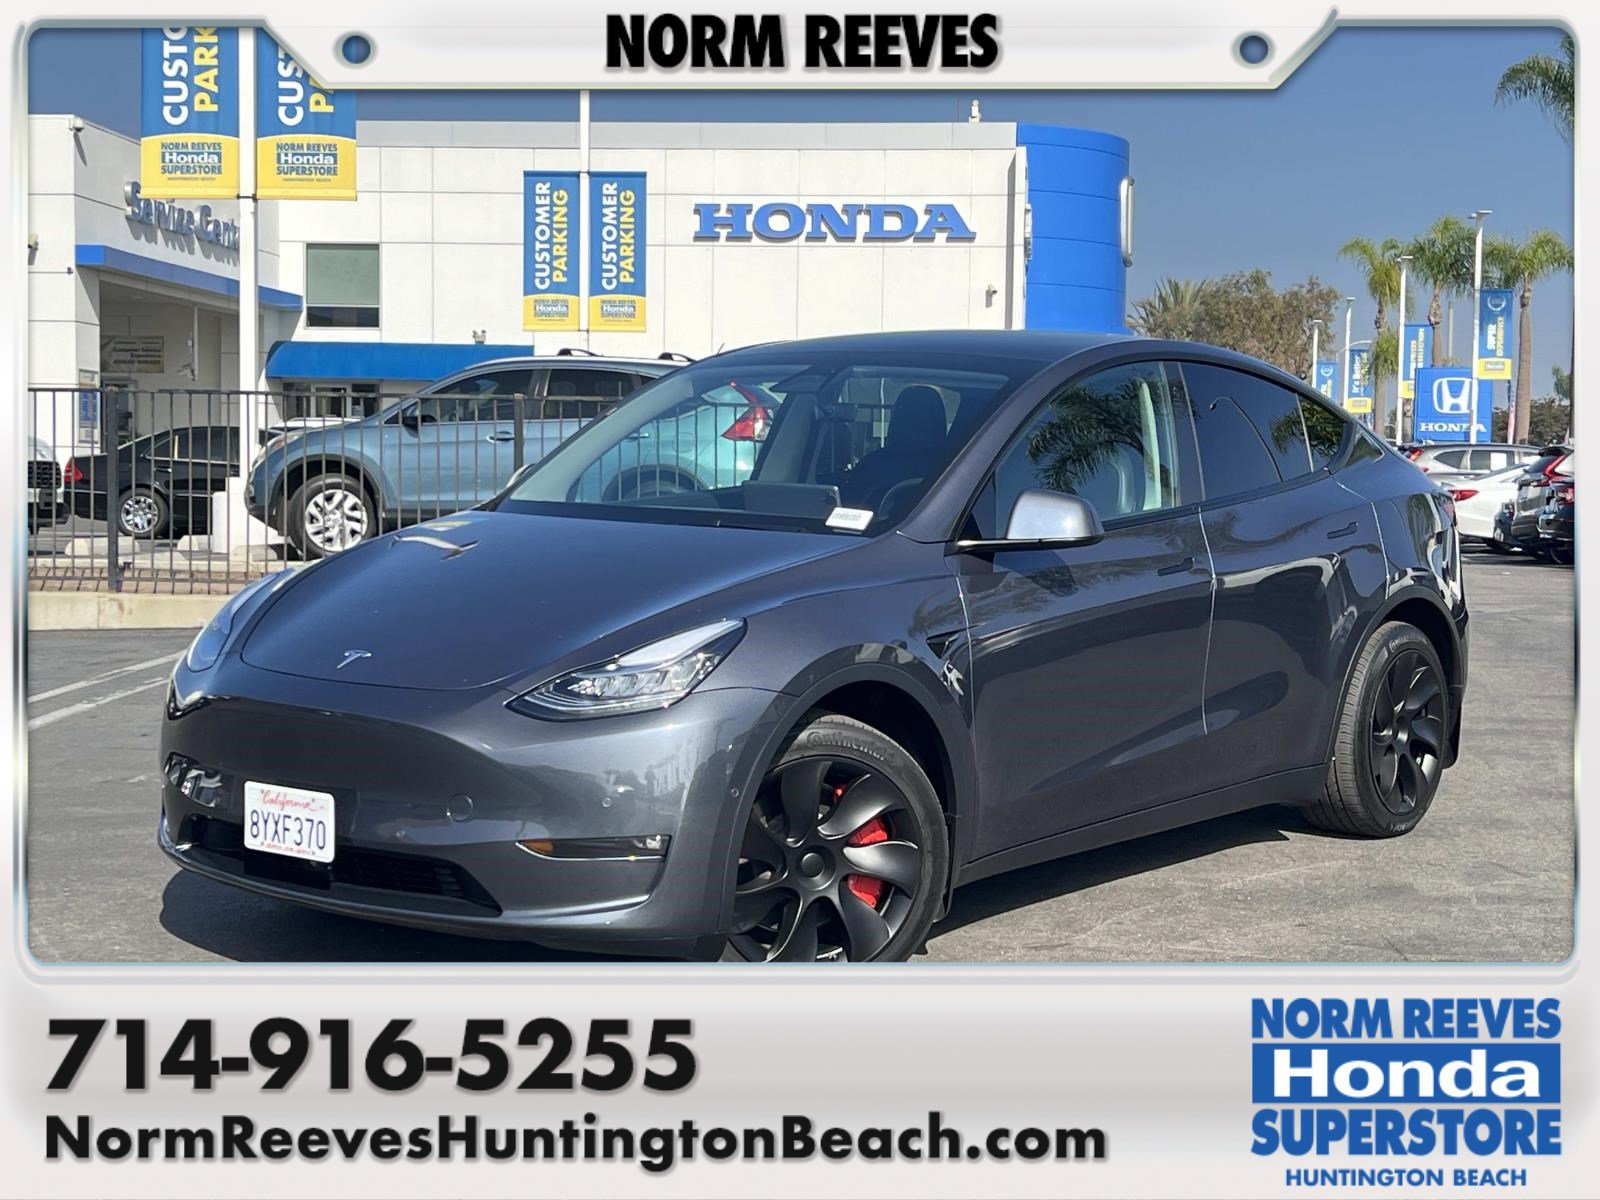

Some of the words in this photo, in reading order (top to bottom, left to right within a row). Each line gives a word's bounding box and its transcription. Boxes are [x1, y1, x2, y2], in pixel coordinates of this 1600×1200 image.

[161, 142, 189, 151] NORM
[191, 142, 222, 151] REEVES
[276, 143, 304, 152] NORM
[307, 143, 337, 152] REEVES
[165, 152, 219, 163] Honda
[280, 153, 334, 165] Honda
[161, 165, 222, 175] SUPERSTORE
[276, 166, 338, 176] SUPERSTORE
[693, 203, 976, 242] HONDA
[534, 182, 551, 290] CUSTOMER
[553, 190, 568, 282] PARKING
[601, 182, 618, 290] CUSTOMER
[620, 190, 635, 283] PARKING
[536, 304, 568, 312] Honda
[602, 305, 634, 313] Honda
[250, 809, 326, 850] 8YXF370
